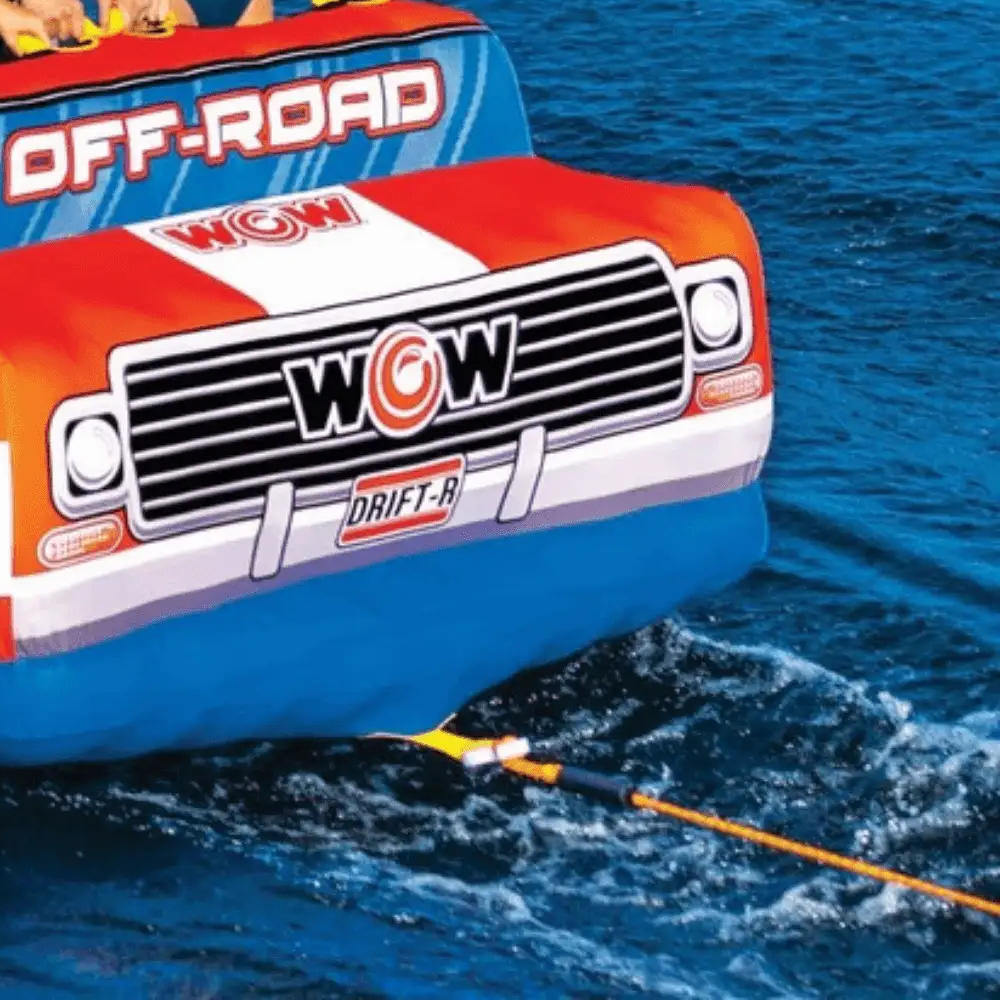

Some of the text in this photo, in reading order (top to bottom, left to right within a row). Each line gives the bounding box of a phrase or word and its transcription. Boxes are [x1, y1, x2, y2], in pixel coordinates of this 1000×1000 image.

[5, 60, 443, 205] OFF-ROAD
[155, 194, 360, 252] WOW
[282, 315, 517, 438] WOW
[347, 477, 458, 526] DRIFT-R
